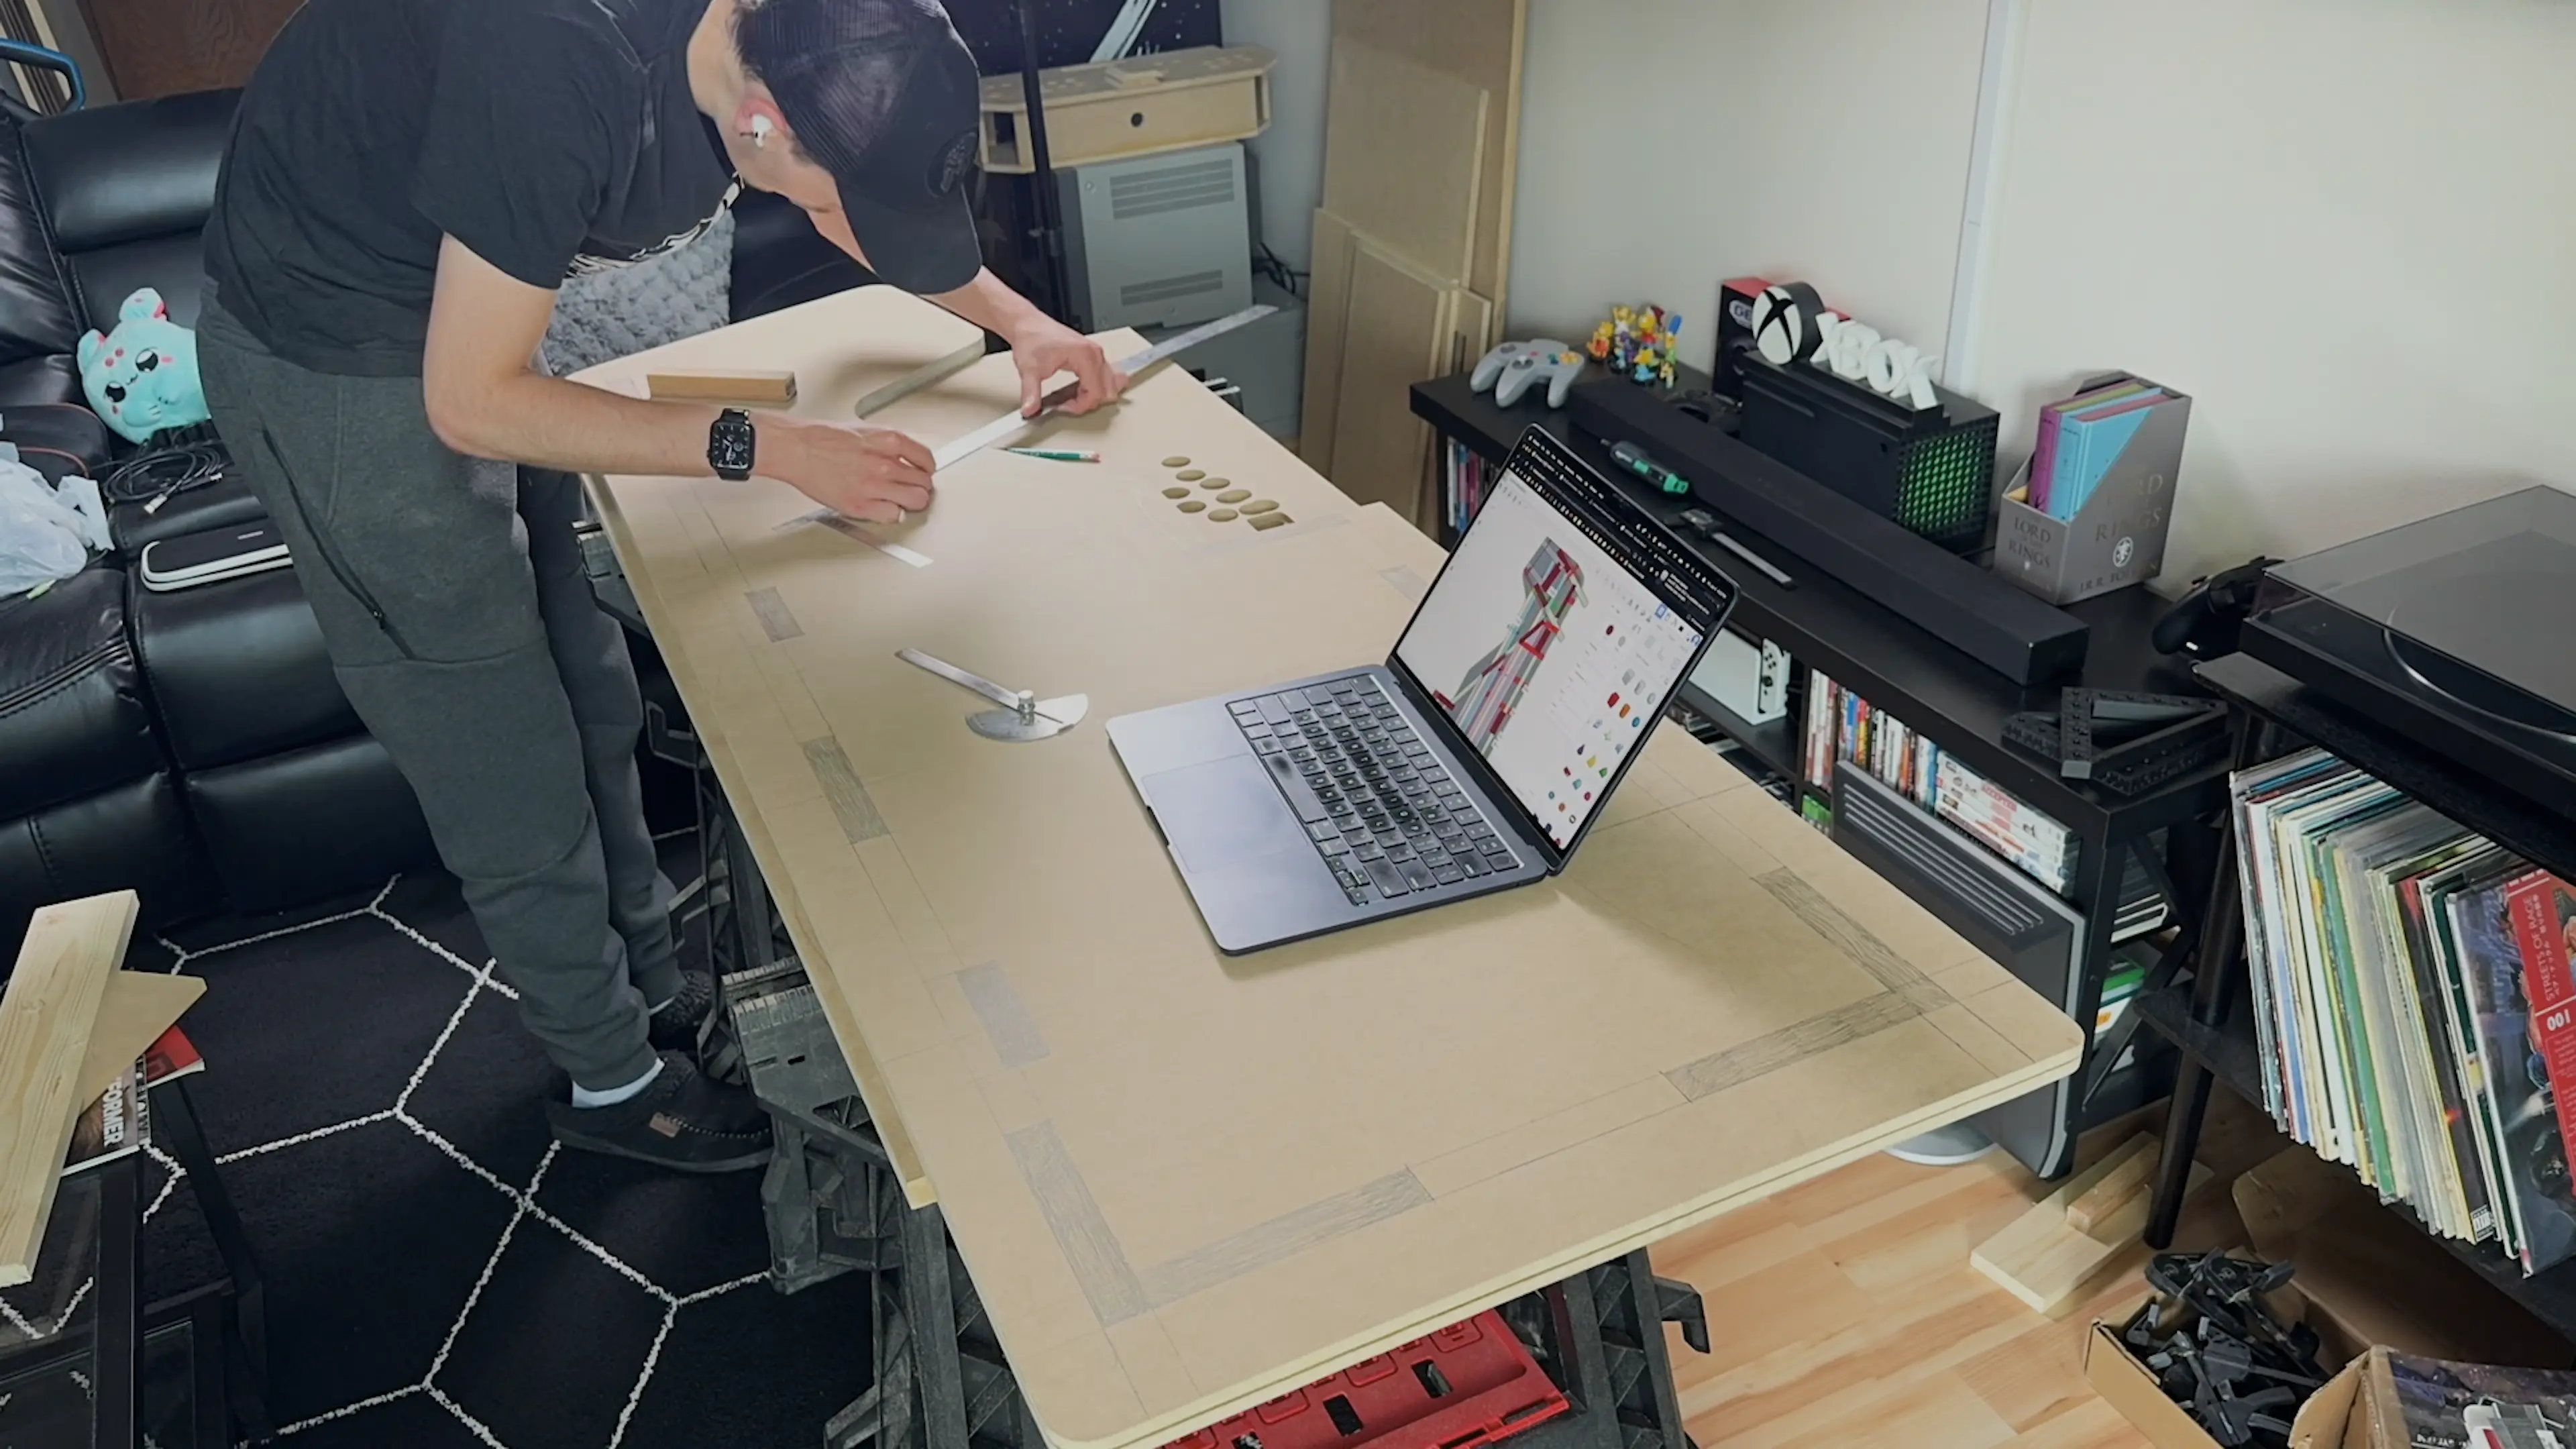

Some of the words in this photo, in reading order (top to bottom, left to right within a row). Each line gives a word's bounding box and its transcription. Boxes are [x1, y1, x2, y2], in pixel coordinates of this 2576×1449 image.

[1809, 311, 1939, 411] XBOX
[2014, 517, 2051, 543] LORD
[2008, 538, 2051, 568] RINGS
